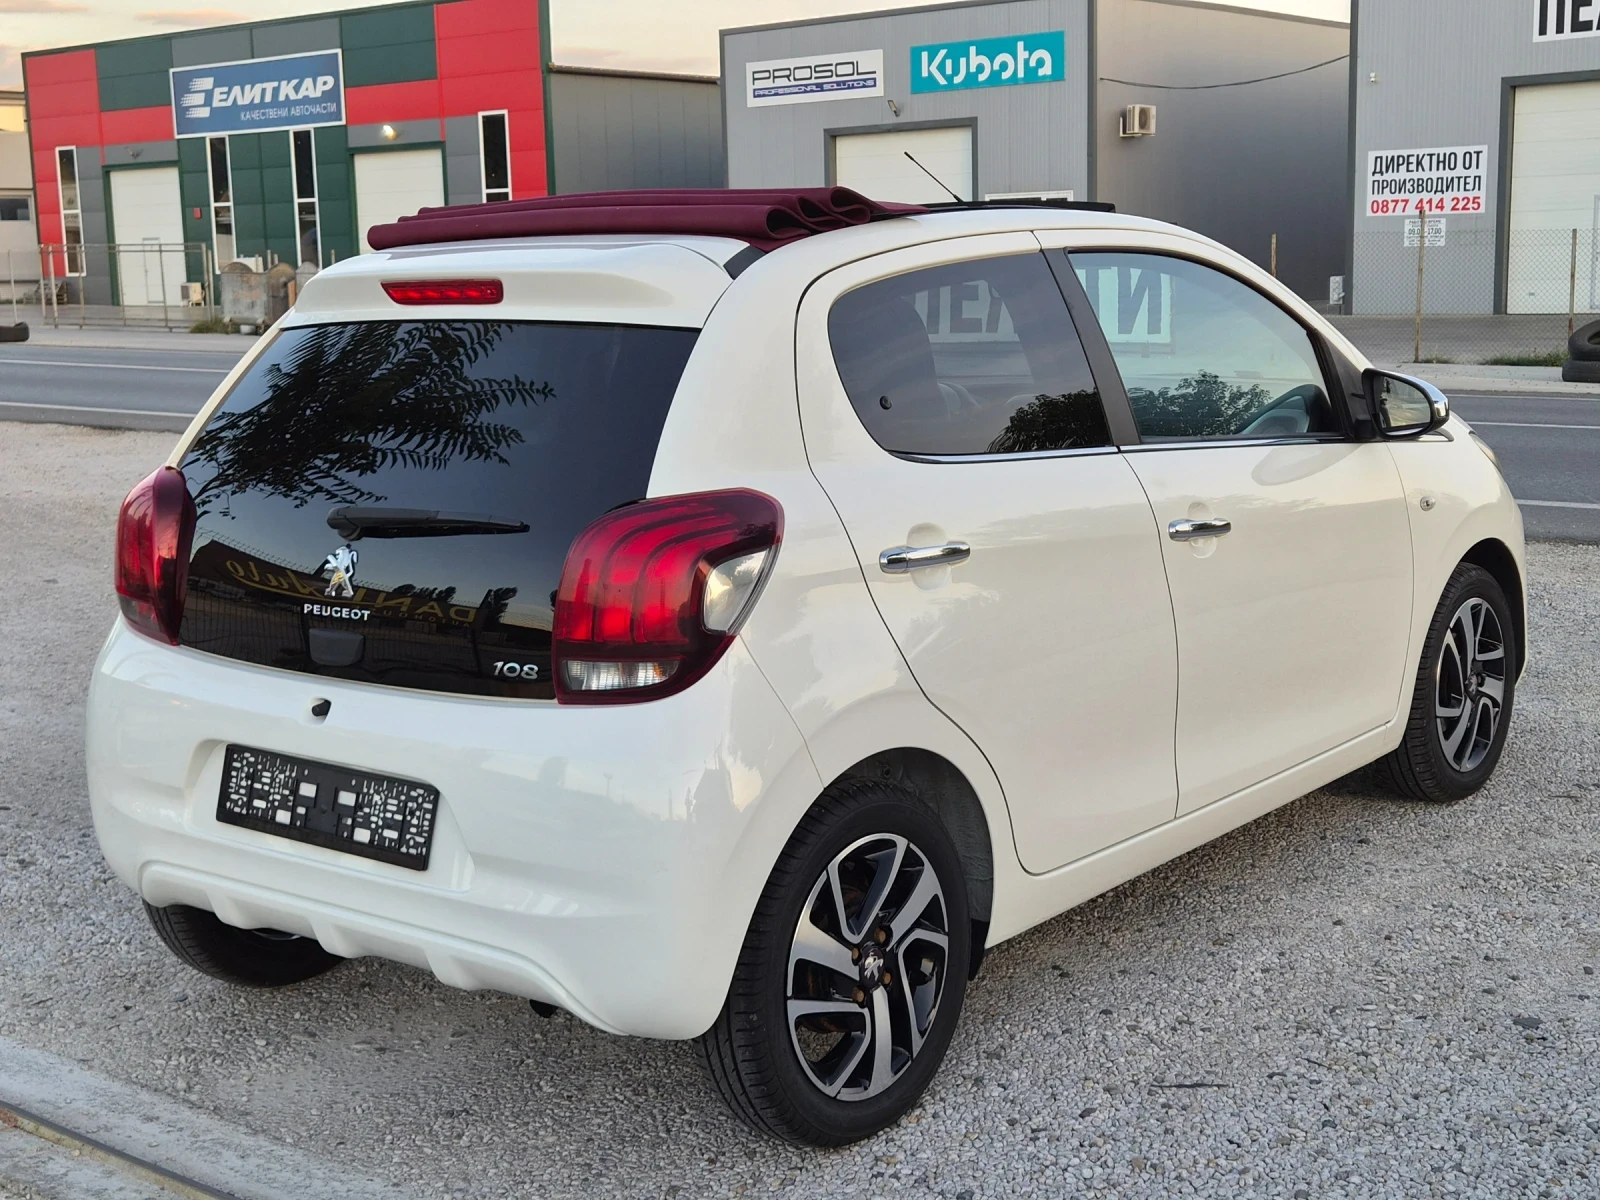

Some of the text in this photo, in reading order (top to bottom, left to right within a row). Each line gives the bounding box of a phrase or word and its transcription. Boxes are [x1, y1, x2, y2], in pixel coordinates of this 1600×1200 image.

[921, 40, 1052, 85] Kubota
[752, 61, 877, 86] PROSOL
[754, 79, 875, 96] PROFESSIONAL SOLUTIONS
[240, 102, 337, 121] КАЧЕСТВЕНИ АВТОЧАСТИ
[1372, 150, 1483, 177] ДИРЕКТНО ОТ
[1371, 175, 1481, 195] ПРОИЗВОДИТЕЛ
[1370, 196, 1481, 214] 0877 414 225
[303, 603, 371, 622] PEUGEOT
[493, 661, 539, 680] 108
